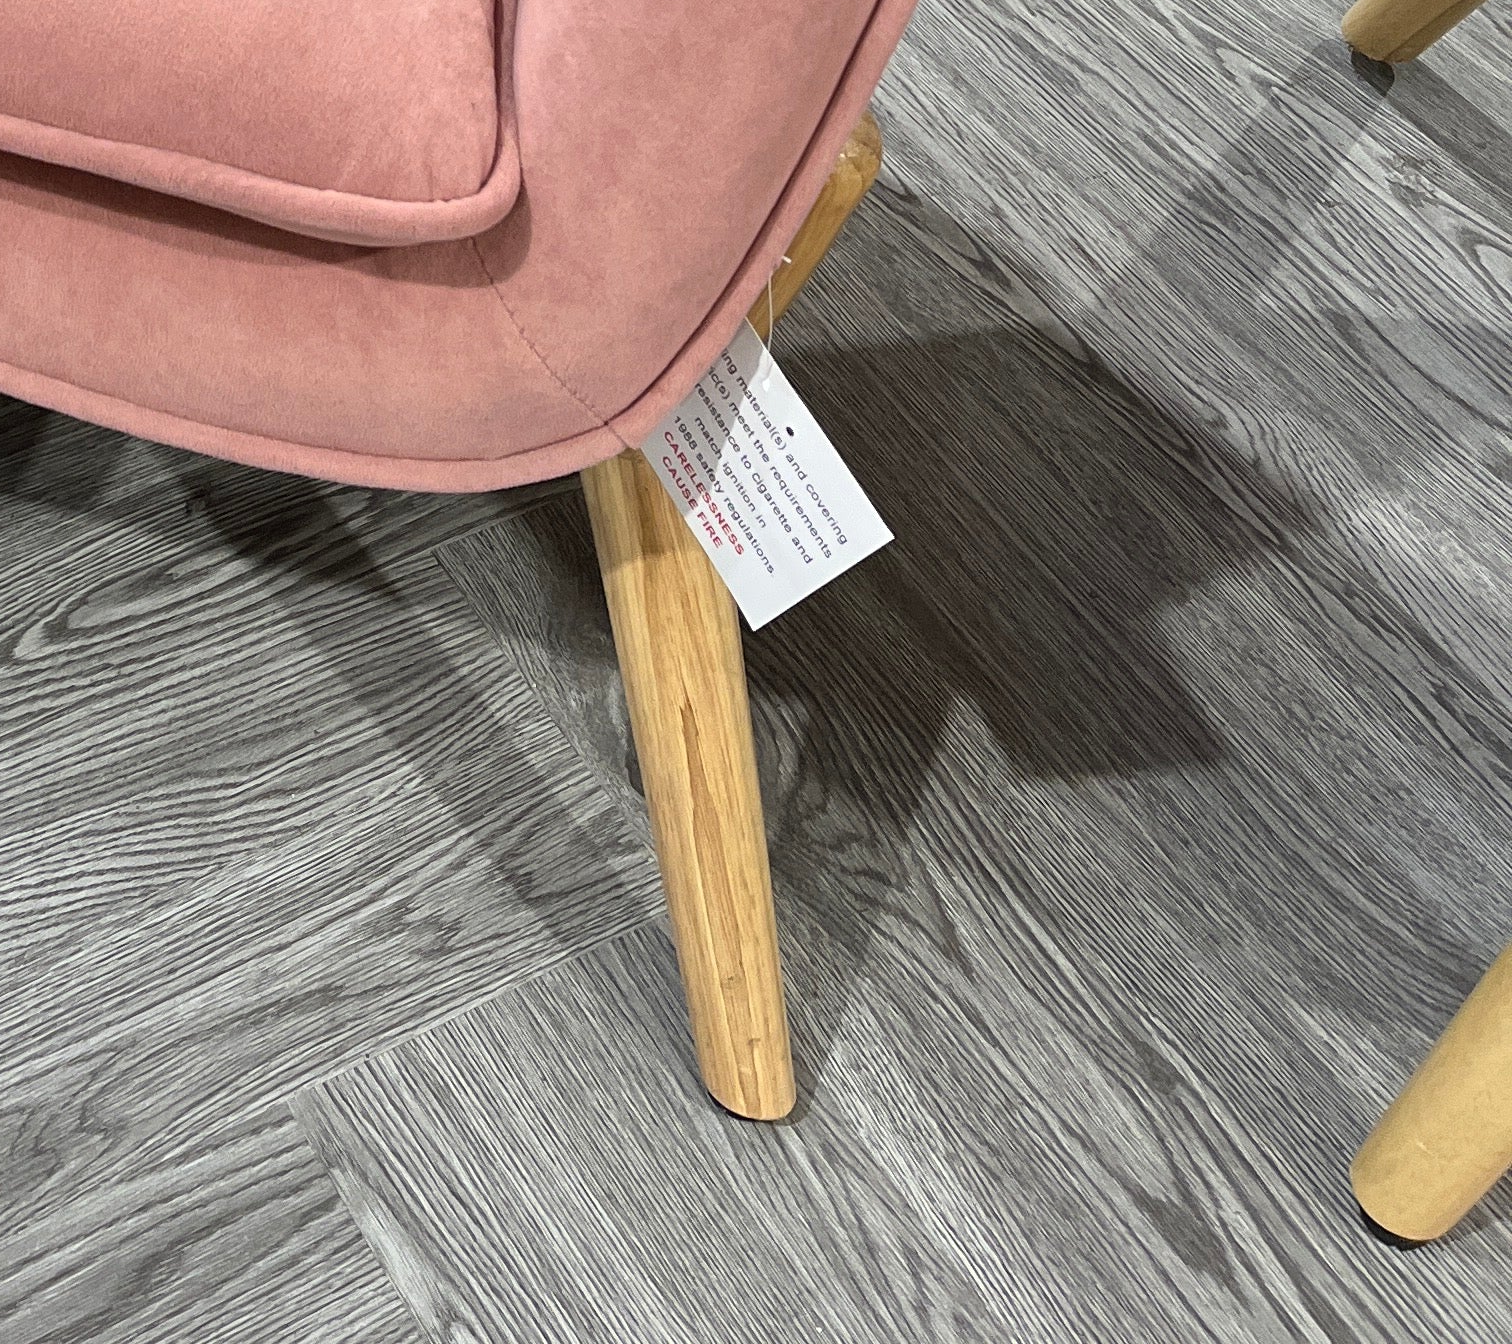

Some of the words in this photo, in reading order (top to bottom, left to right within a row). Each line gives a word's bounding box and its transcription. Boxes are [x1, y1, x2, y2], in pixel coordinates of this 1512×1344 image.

[662, 456, 699, 510] CAUSE
[696, 511, 724, 549] FIRE
[664, 431, 745, 556] CARELESSNESS
[673, 415, 698, 450] 1988
[696, 452, 725, 494] safety
[694, 417, 723, 460] match
[722, 461, 756, 512] ignition
[755, 514, 767, 528] in
[694, 382, 741, 453] resistance
[740, 454, 752, 470] to
[791, 536, 814, 564] and
[729, 402, 755, 438] meet
[753, 439, 770, 463] the
[769, 466, 832, 559] requirements
[736, 376, 787, 450] material(s)
[785, 453, 808, 481] and
[806, 483, 848, 545] covering
